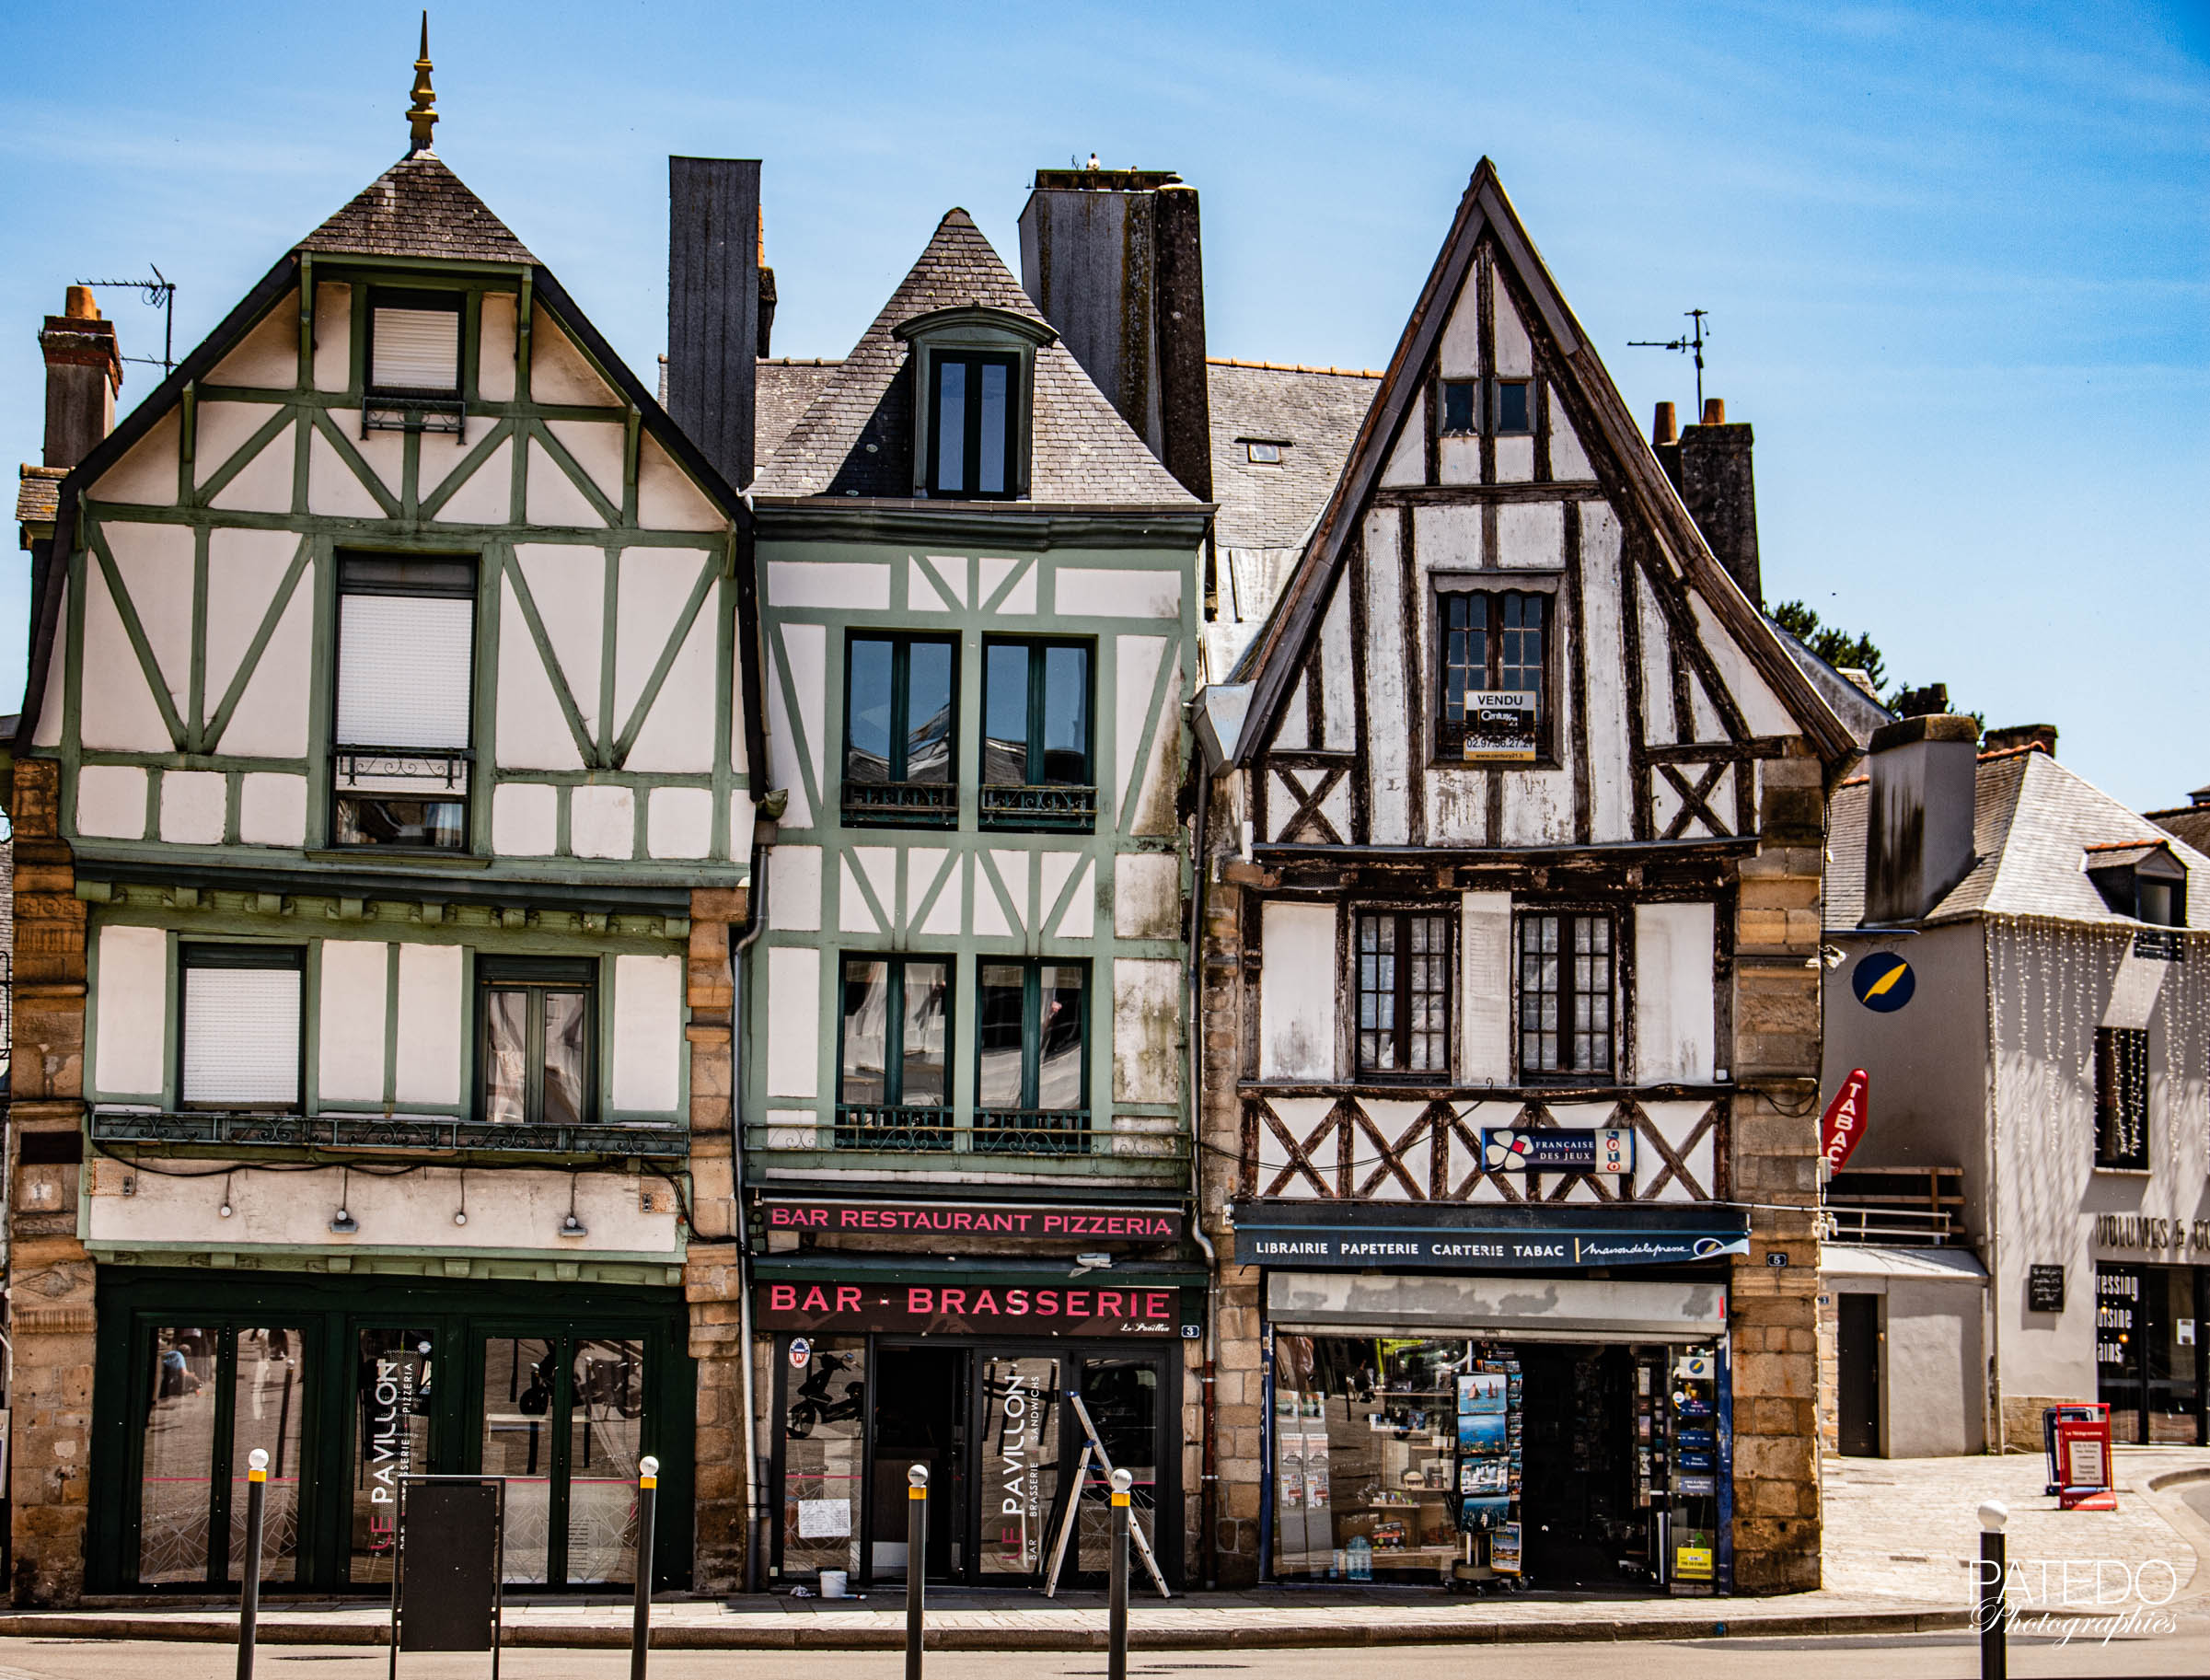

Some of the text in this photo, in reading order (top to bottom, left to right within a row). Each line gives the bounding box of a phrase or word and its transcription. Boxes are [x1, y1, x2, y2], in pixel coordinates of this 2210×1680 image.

[1477, 695, 1523, 706] VENDU
[1826, 1082, 1862, 1162] TABAC
[1535, 1141, 1594, 1153] FRANÇAISE
[1540, 1152, 1591, 1162] DES JEUX
[1606, 1130, 1621, 1172] LOTO
[771, 1208, 1172, 1235] BAR RESTAURANT PIZZERIA
[2096, 1214, 2169, 1249] VOLUMES
[1255, 1242, 1565, 1257] LIBRAIRIE PAPETERIE CARTERIE TABAC
[1774, 1256, 1781, 1265] 5
[770, 1285, 1170, 1318] BAR BRASSERIE
[1186, 1327, 1194, 1336] 3
[402, 1362, 413, 1414] PIZZERIA
[370, 1361, 399, 1550] LE PAVILLON
[1001, 1375, 1025, 1560] LE PAVILLON
[1028, 1376, 1040, 1560] BAR BRASSERIE SANDWICHS
